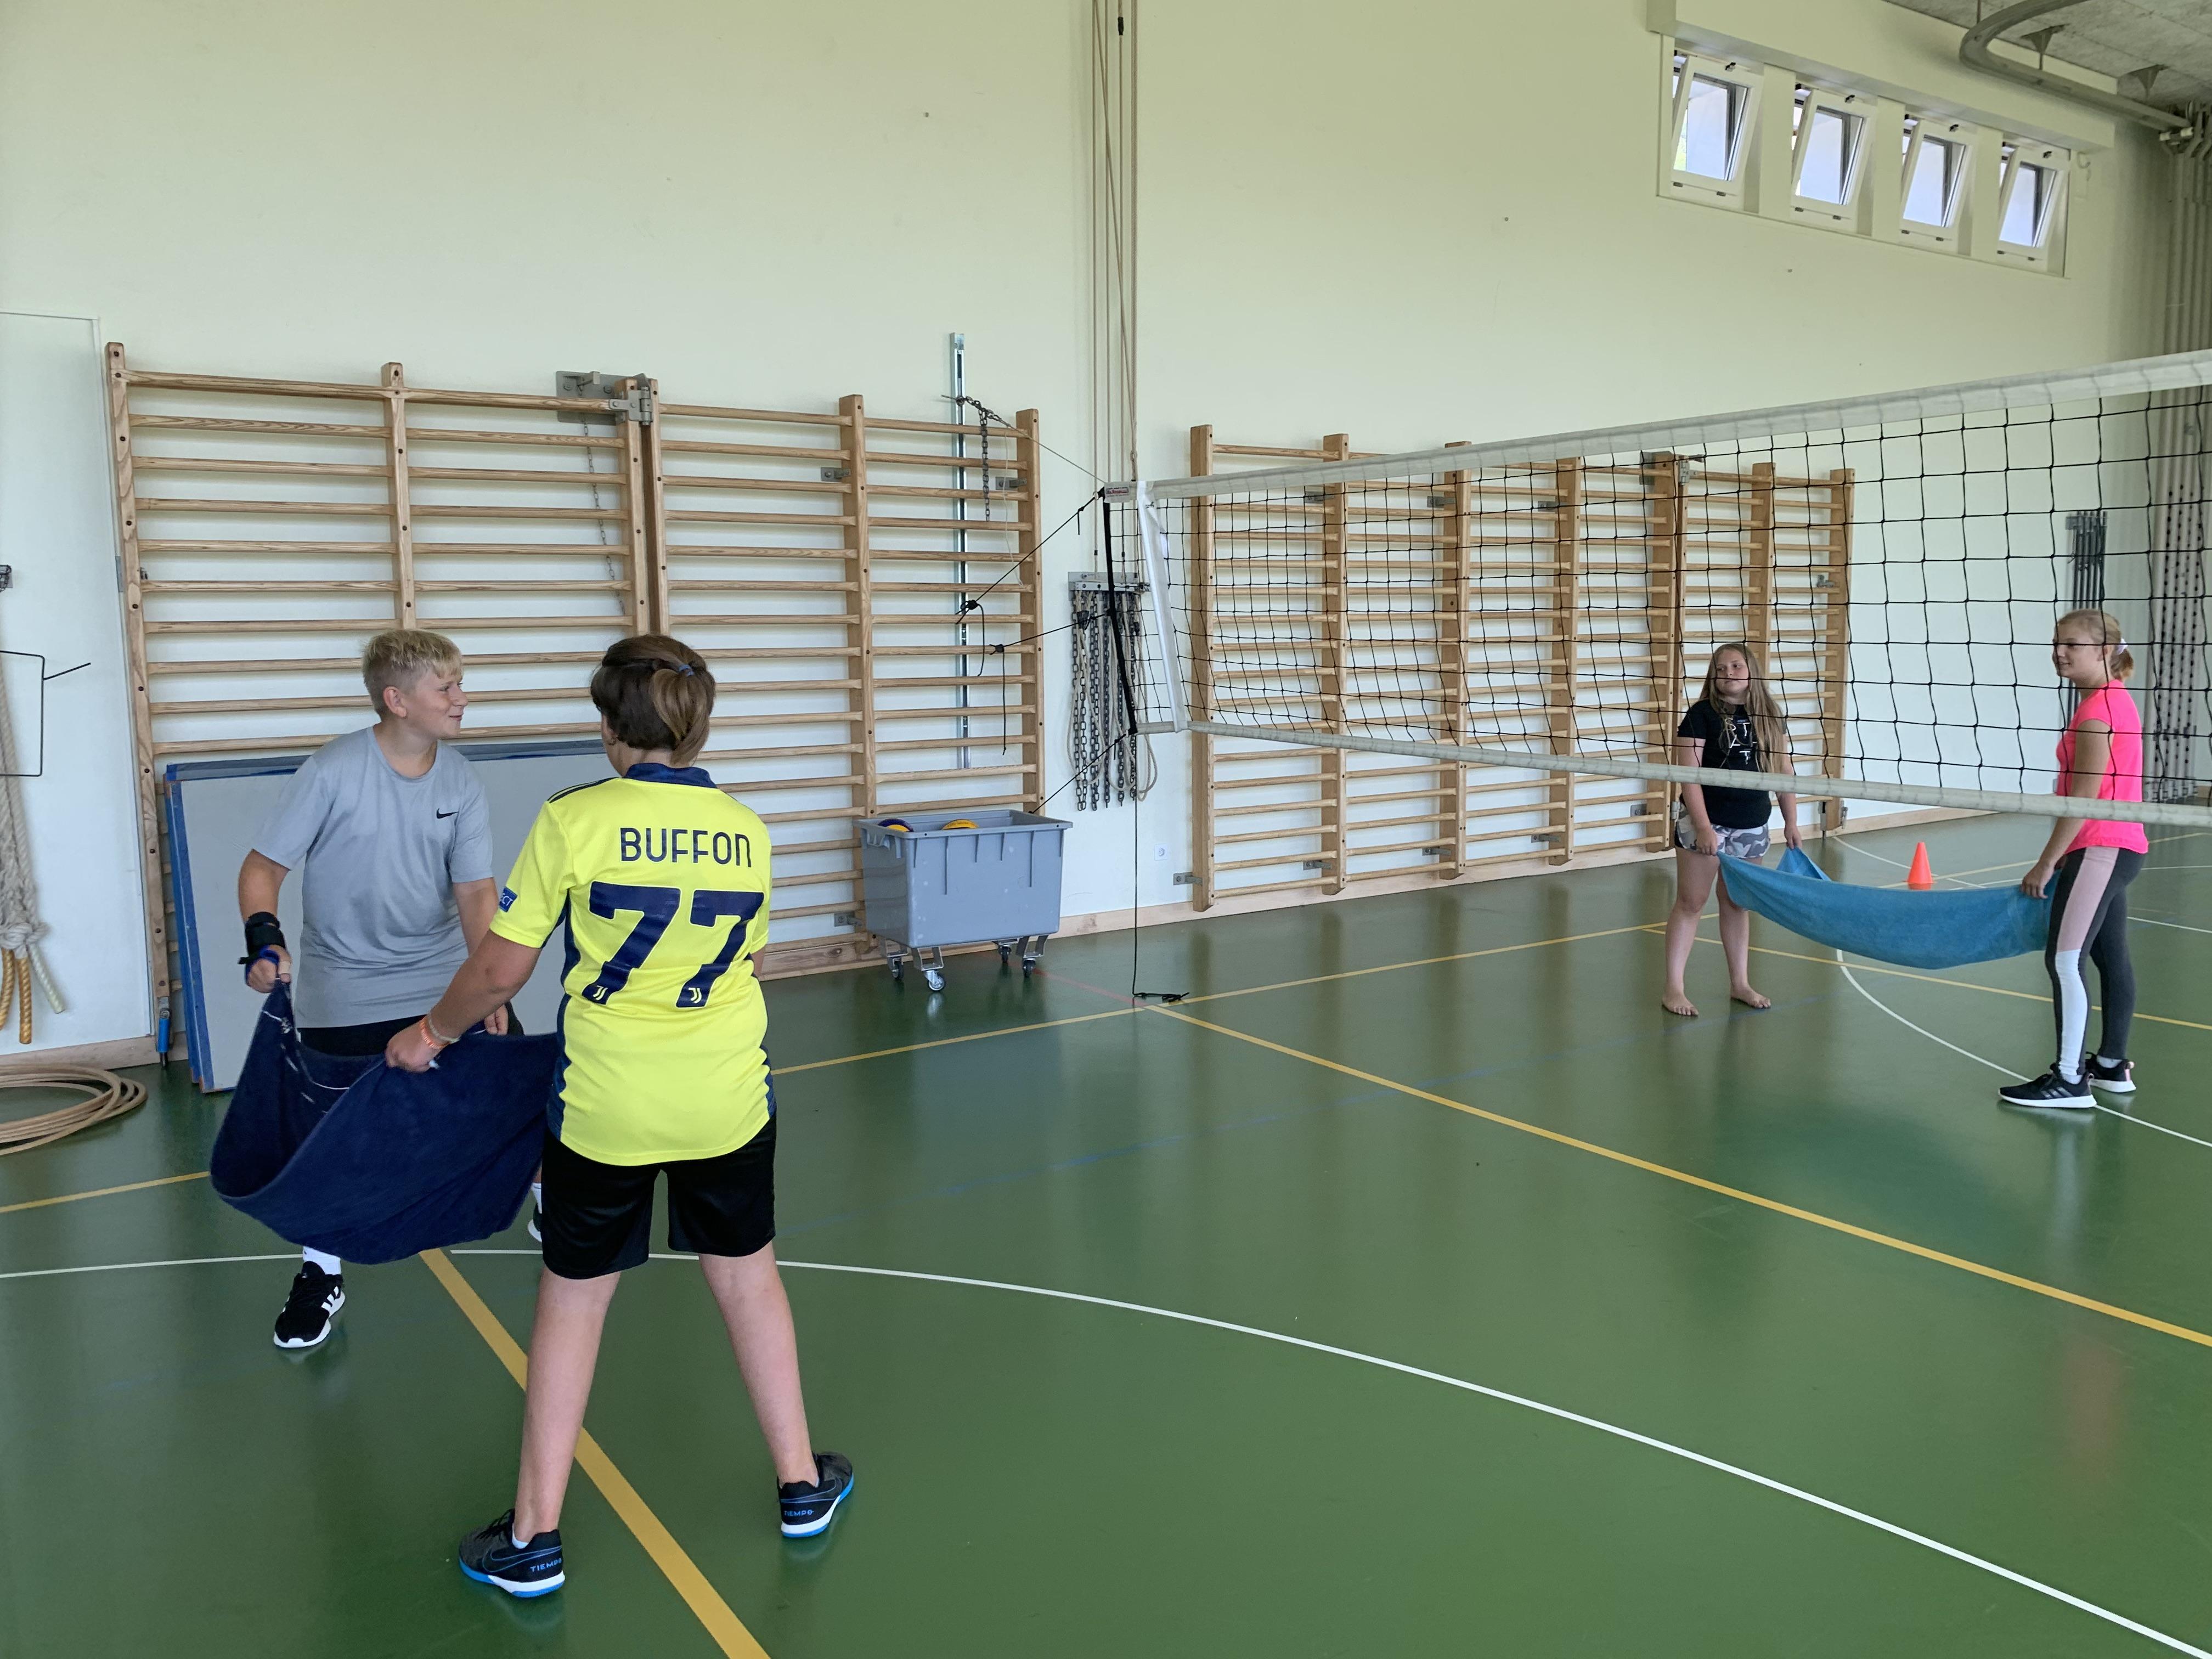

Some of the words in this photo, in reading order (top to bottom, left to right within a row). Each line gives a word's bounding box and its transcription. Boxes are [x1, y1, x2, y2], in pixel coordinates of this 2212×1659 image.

[620, 827, 752, 868] BUFFON
[581, 880, 765, 1008] 77
[530, 1558, 562, 1573] TIEMPO
